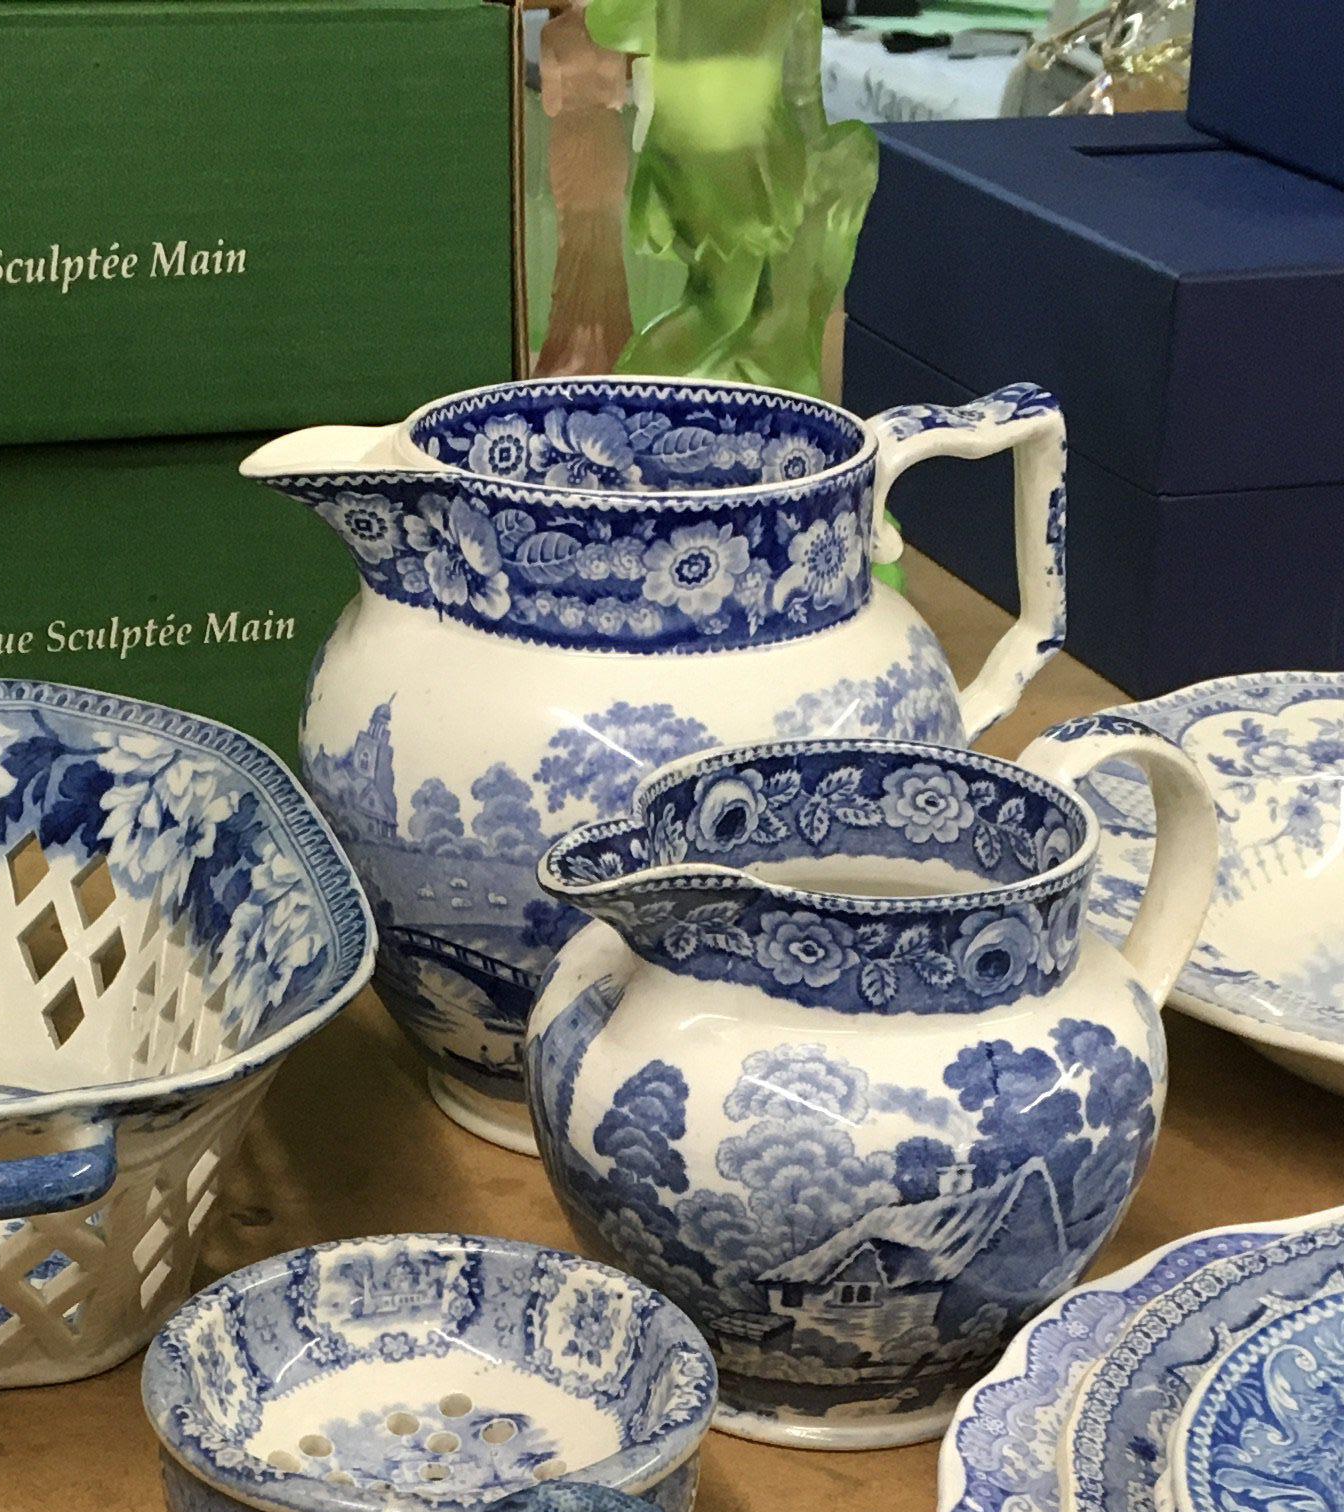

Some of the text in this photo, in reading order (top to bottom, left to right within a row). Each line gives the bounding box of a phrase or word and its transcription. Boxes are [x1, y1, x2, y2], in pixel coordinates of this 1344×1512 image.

[149, 238, 247, 278] Main
[46, 613, 193, 660] Sculptée
[203, 610, 295, 644] Main
